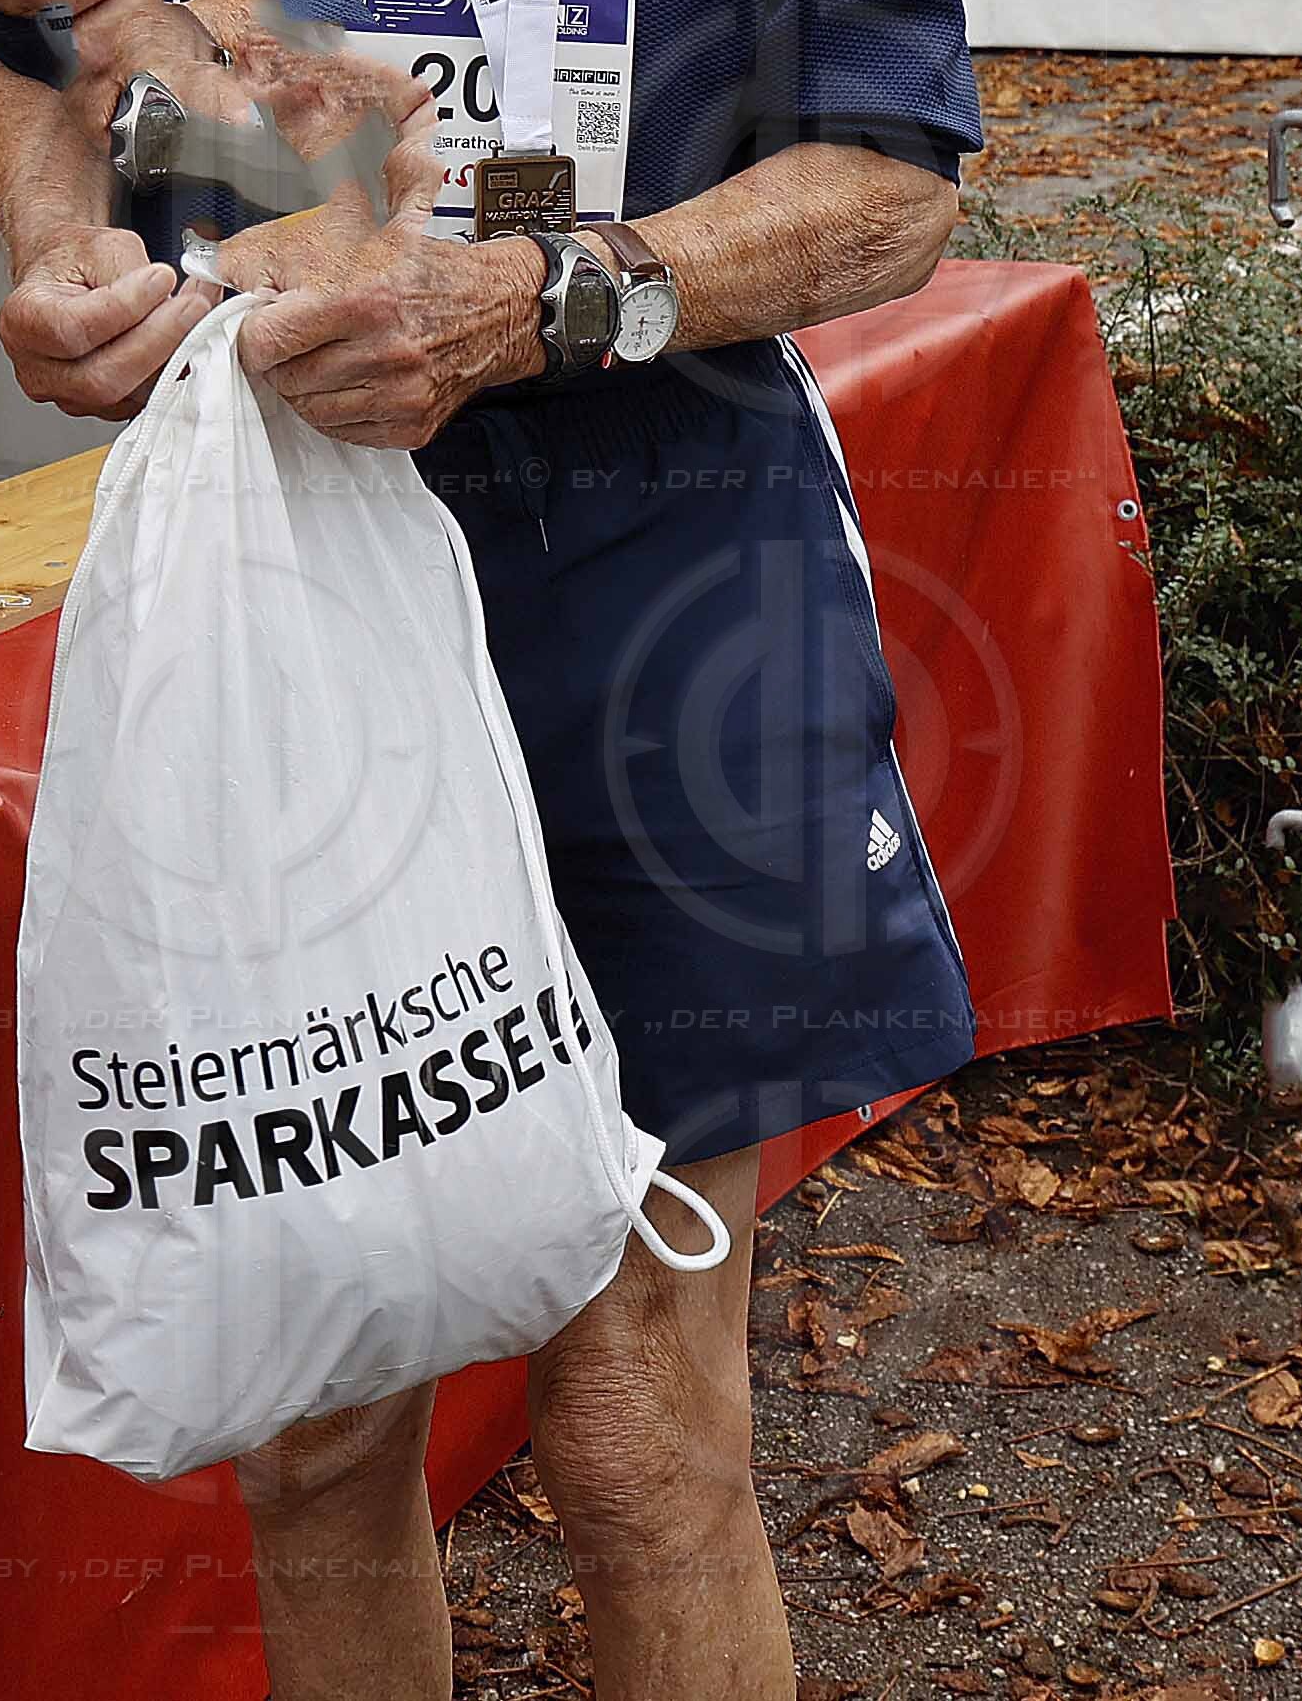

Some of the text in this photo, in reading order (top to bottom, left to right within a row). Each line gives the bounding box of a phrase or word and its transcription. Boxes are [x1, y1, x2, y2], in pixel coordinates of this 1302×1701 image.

[435, 135, 505, 151] aratho
[498, 190, 555, 210] GRAZ
[485, 210, 539, 221] MARATHON
[867, 832, 901, 871] adidas
[83, 1005, 546, 1210] SPARKASSE
